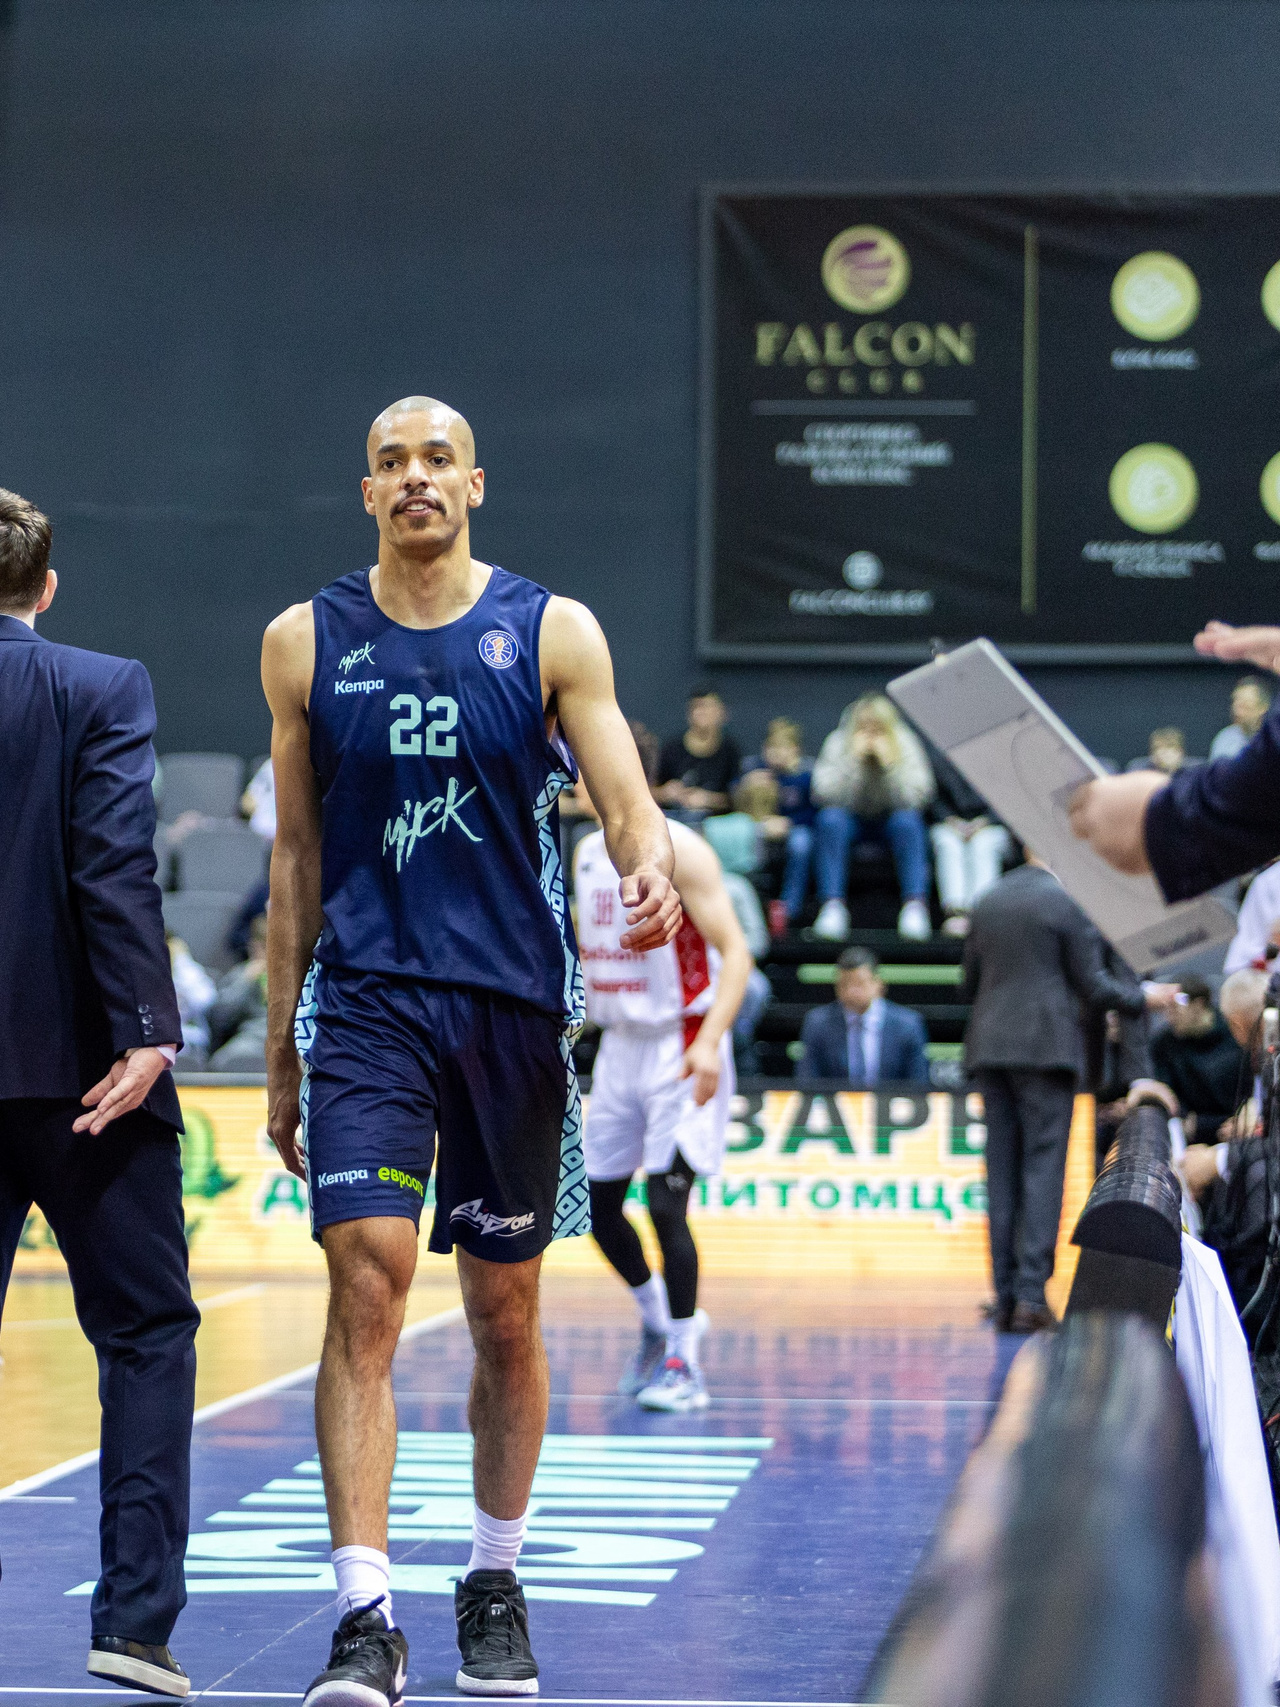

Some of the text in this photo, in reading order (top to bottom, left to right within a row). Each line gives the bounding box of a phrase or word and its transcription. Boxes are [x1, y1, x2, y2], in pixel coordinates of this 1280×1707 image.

[754, 321, 975, 367] FALCON
[334, 679, 385, 695] Kempa
[390, 694, 458, 757] 22
[318, 1169, 368, 1188] Kempa
